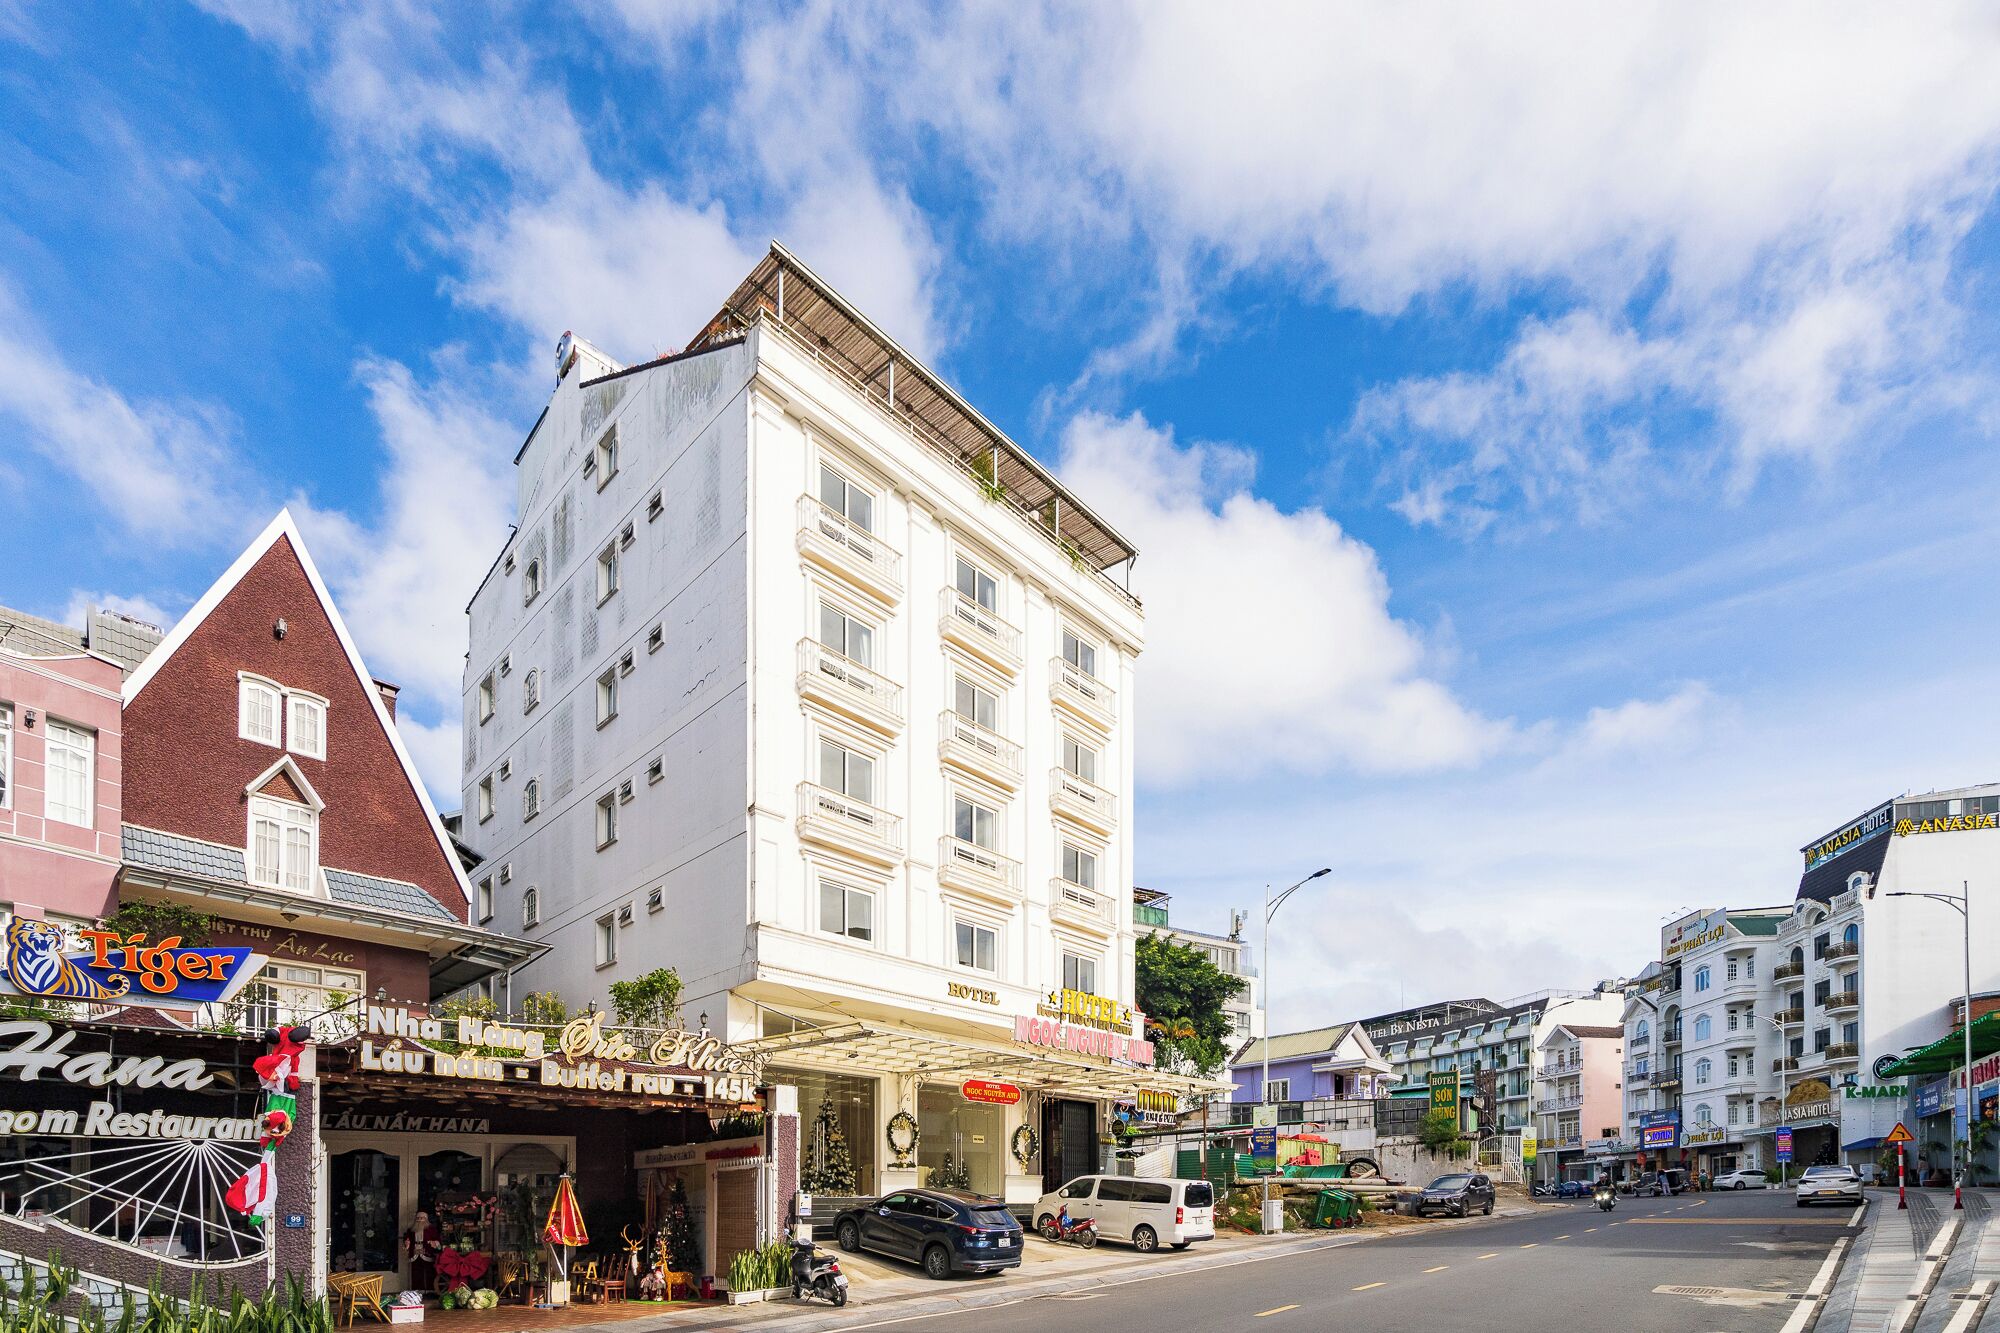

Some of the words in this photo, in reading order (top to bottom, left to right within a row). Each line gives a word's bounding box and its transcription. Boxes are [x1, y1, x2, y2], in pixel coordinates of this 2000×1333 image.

[1818, 825, 1861, 858] ANASIA
[1863, 810, 1890, 835] HOTEL
[1919, 815, 1995, 833] ANASIA
[240, 926, 272, 941] THỰ
[80, 930, 235, 994] Tiger
[948, 982, 1000, 1005] HOTEL
[1061, 988, 1121, 1024] HOTEL
[368, 1006, 442, 1040] Nhà
[458, 1015, 545, 1059] Hàng
[0, 1021, 214, 1091] Hana
[1126, 1038, 1154, 1065] ANH
[361, 1039, 426, 1074] Lẩu
[434, 1048, 504, 1081] nấm
[541, 1059, 626, 1092] Buffet
[632, 1074, 675, 1096] rau
[703, 1075, 757, 1103] 145k
[1432, 1076, 1456, 1086] HOTEL
[1435, 1087, 1453, 1102] SƠN
[373, 1110, 422, 1131] NẤM
[428, 1116, 490, 1133] HANA
[1807, 1102, 1832, 1117] HOTEL
